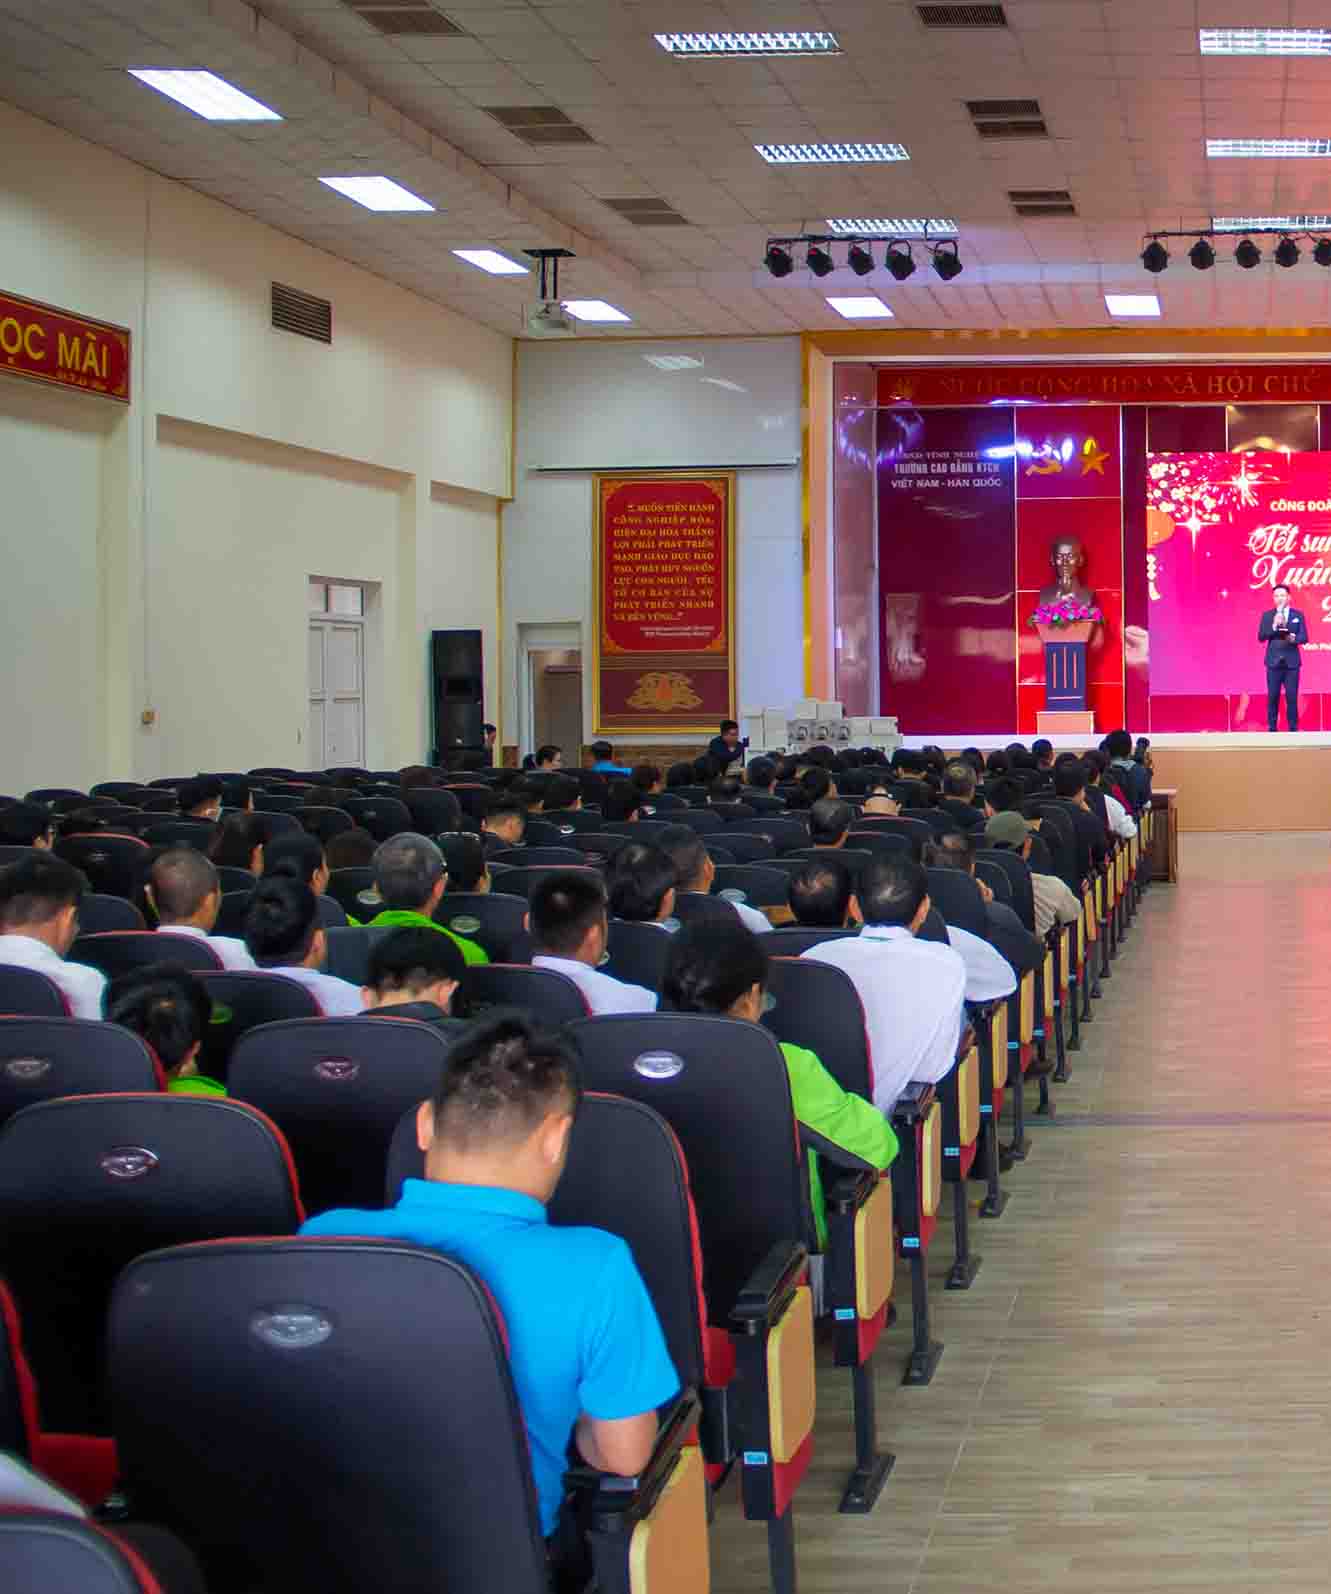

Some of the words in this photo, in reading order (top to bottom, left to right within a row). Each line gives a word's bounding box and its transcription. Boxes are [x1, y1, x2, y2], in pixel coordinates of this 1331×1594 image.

[1206, 369, 1257, 398] HỘI
[890, 477, 912, 489] VIỆT
[916, 479, 940, 488] NAM
[1270, 498, 1306, 511] CÔNG
[1249, 523, 1299, 555] Tết
